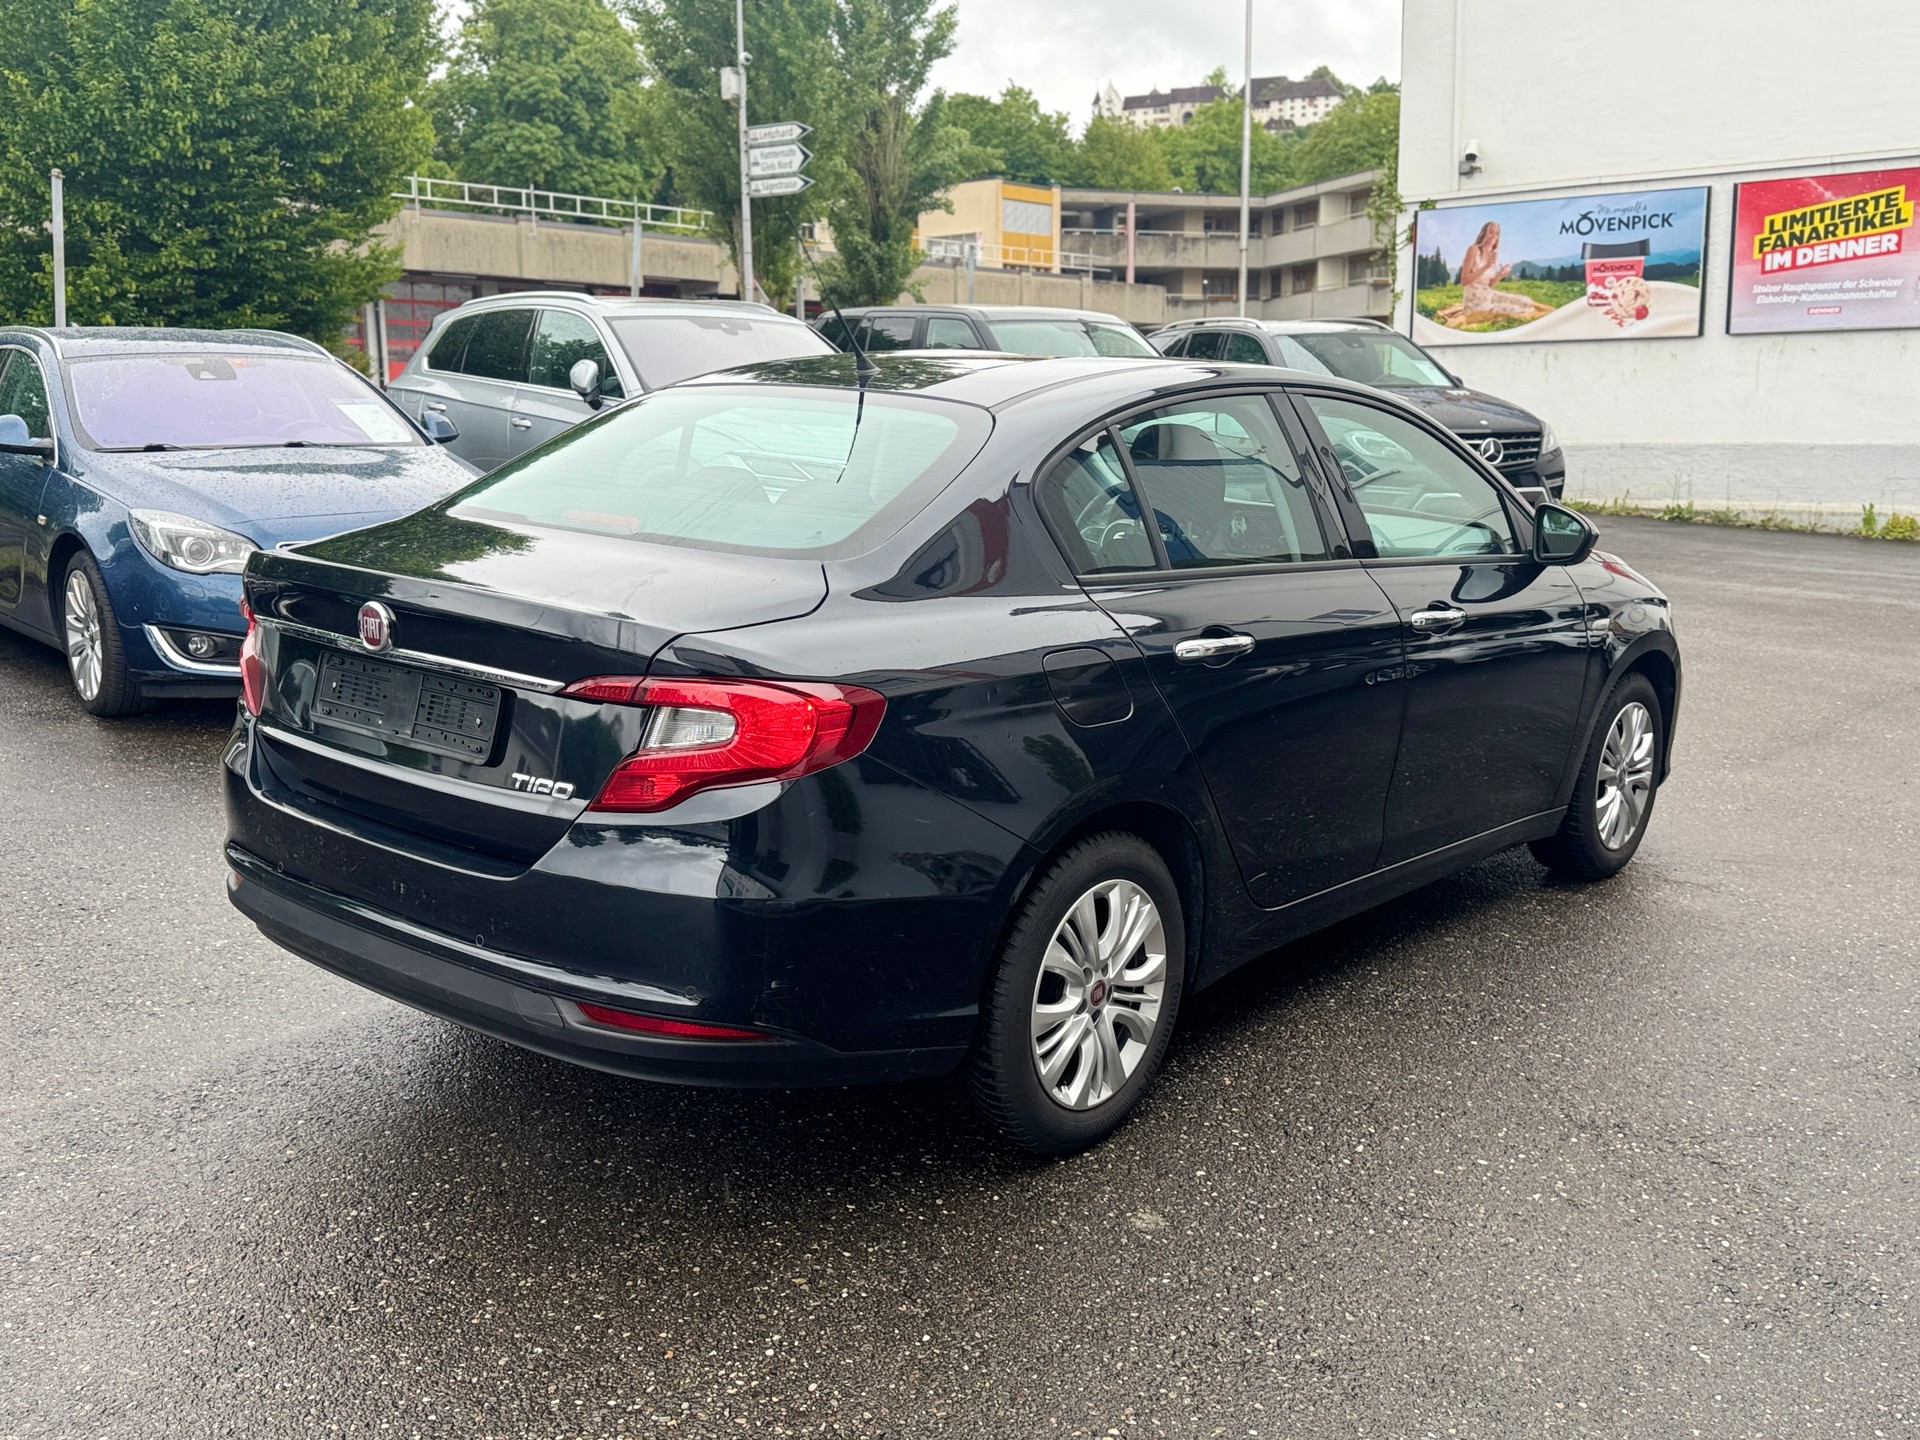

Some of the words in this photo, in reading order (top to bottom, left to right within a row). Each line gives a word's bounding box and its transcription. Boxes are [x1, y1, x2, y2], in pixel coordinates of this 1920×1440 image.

[759, 128, 794, 140] Lenzhard
[778, 160, 793, 169] Nord
[1613, 201, 1641, 216] myself
[1768, 190, 1901, 235] LIMITIERTE
[1758, 207, 1909, 254] FANARTIKEL
[1764, 252, 1793, 271] IM
[1796, 233, 1899, 266] DENNER
[1751, 283, 1782, 294] Stolzer
[1782, 281, 1842, 293] Hauptsponsor
[1842, 280, 1857, 289] der
[1858, 277, 1904, 288] Schweizer
[1755, 289, 1898, 305] Eishockey-Nationalmannschaften
[363, 615, 381, 640] FIAT
[511, 772, 575, 801] TIPO
